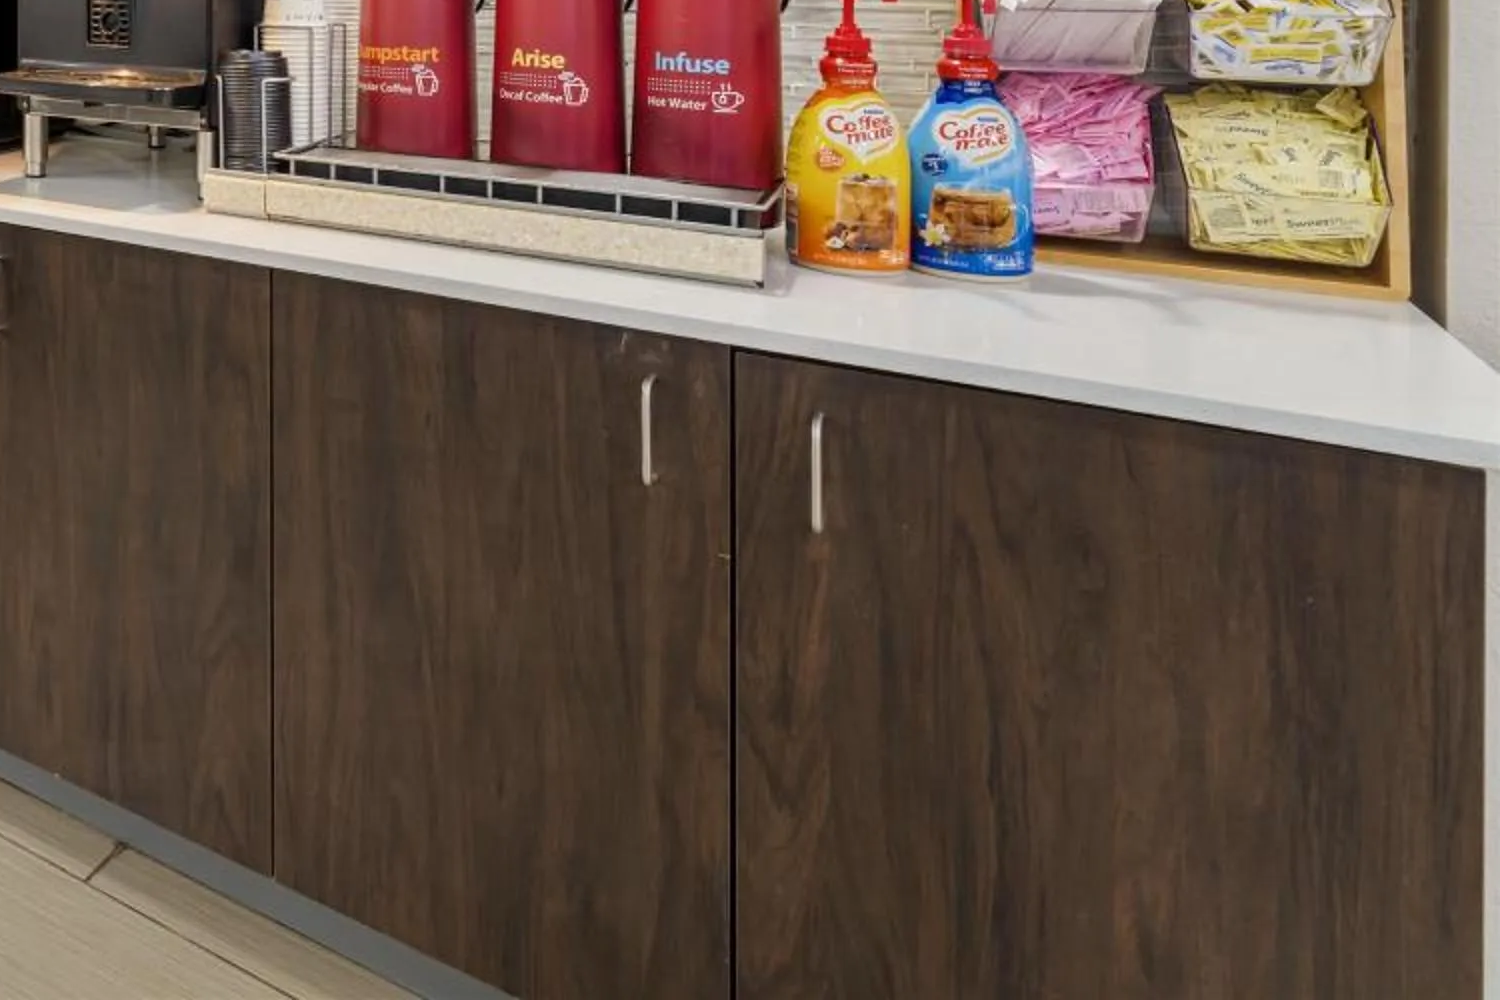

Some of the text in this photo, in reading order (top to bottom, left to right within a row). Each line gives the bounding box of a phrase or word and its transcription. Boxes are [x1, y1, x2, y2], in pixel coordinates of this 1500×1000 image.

[359, 45, 439, 64] umpstart
[511, 47, 565, 69] Arise
[655, 51, 730, 75] Infuse
[500, 87, 563, 105] Decaf Coffee
[647, 95, 707, 111] Hot Water
[826, 115, 891, 134] Coffee
